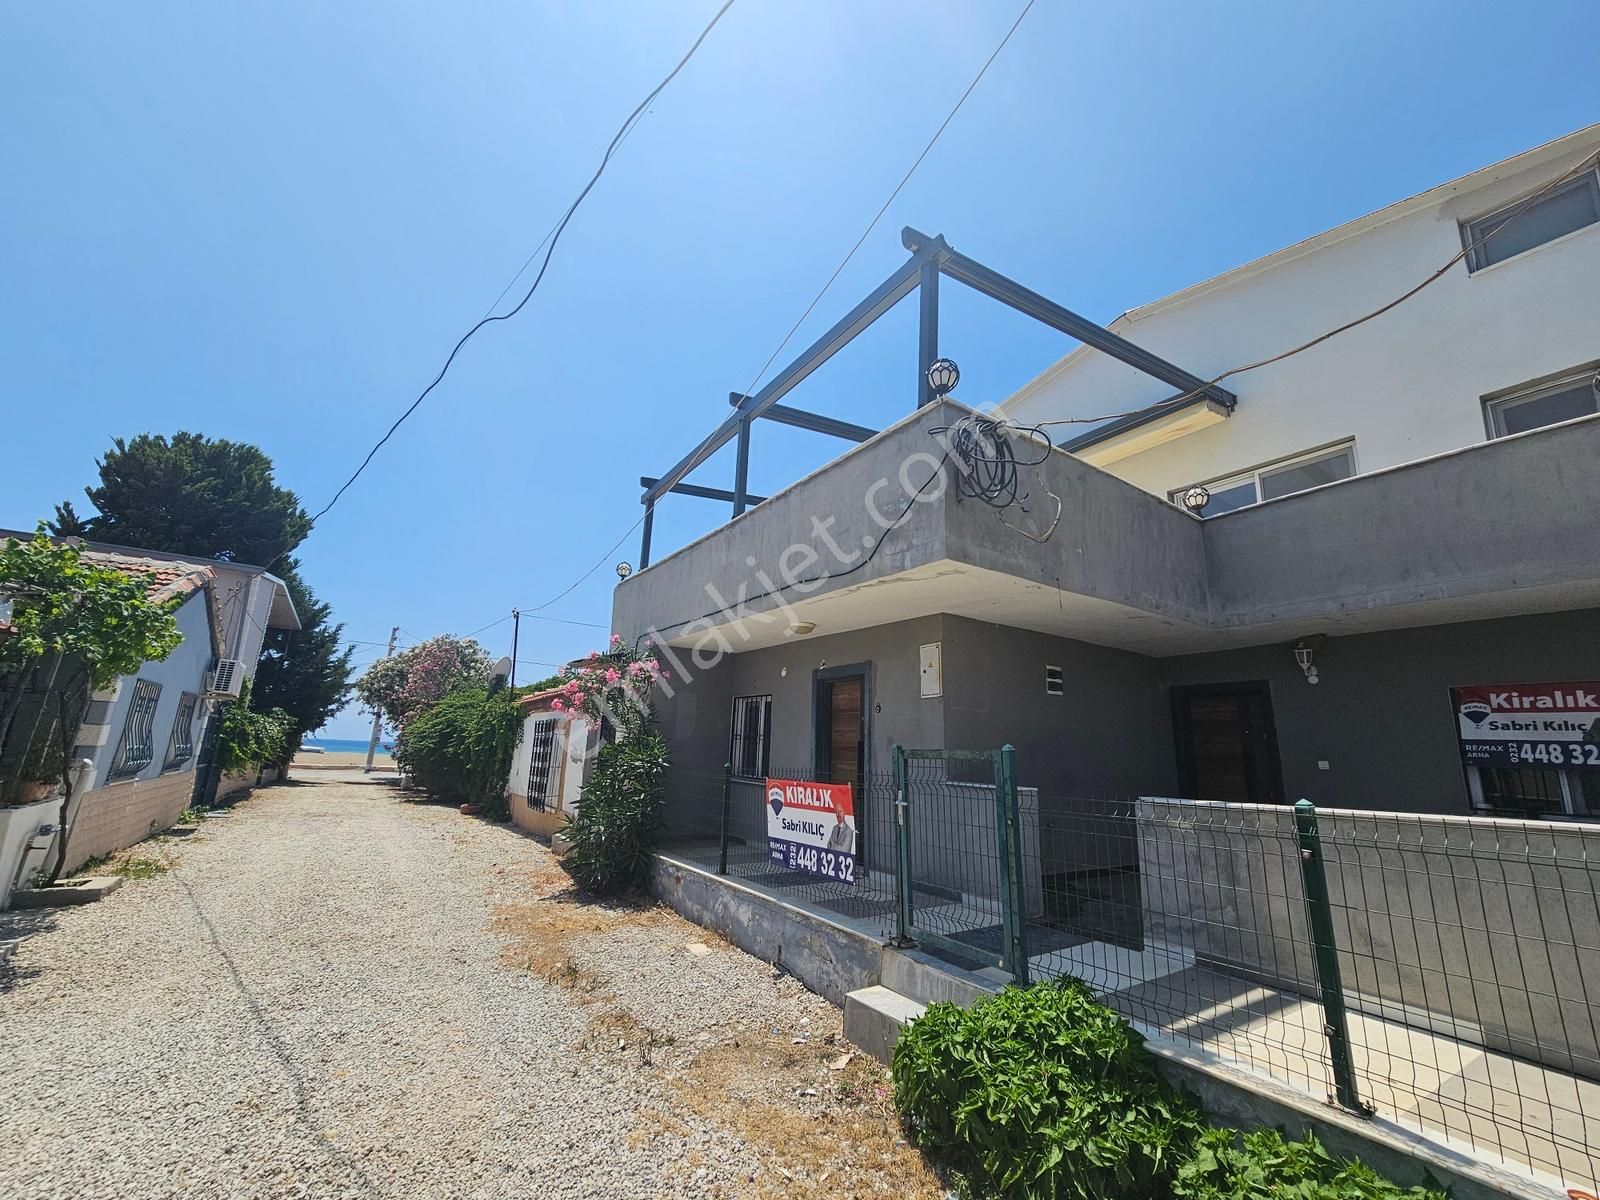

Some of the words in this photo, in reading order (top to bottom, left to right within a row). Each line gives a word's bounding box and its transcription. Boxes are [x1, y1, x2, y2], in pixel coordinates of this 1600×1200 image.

[1489, 690, 1600, 709] Kiralık
[1489, 720, 1538, 731] Sabri
[1543, 720, 1588, 733] Kılıç
[1465, 744, 1504, 752] RE/MAX
[1509, 742, 1519, 763] 0232
[1520, 743, 1564, 764] 448
[1568, 744, 1600, 765] 32
[785, 782, 834, 808] KİRALIK
[782, 818, 801, 832] Sabri
[802, 821, 825, 840] KILIÇ
[797, 847, 818, 872] 448
[820, 852, 836, 876] 32
[838, 855, 854, 882] 32
